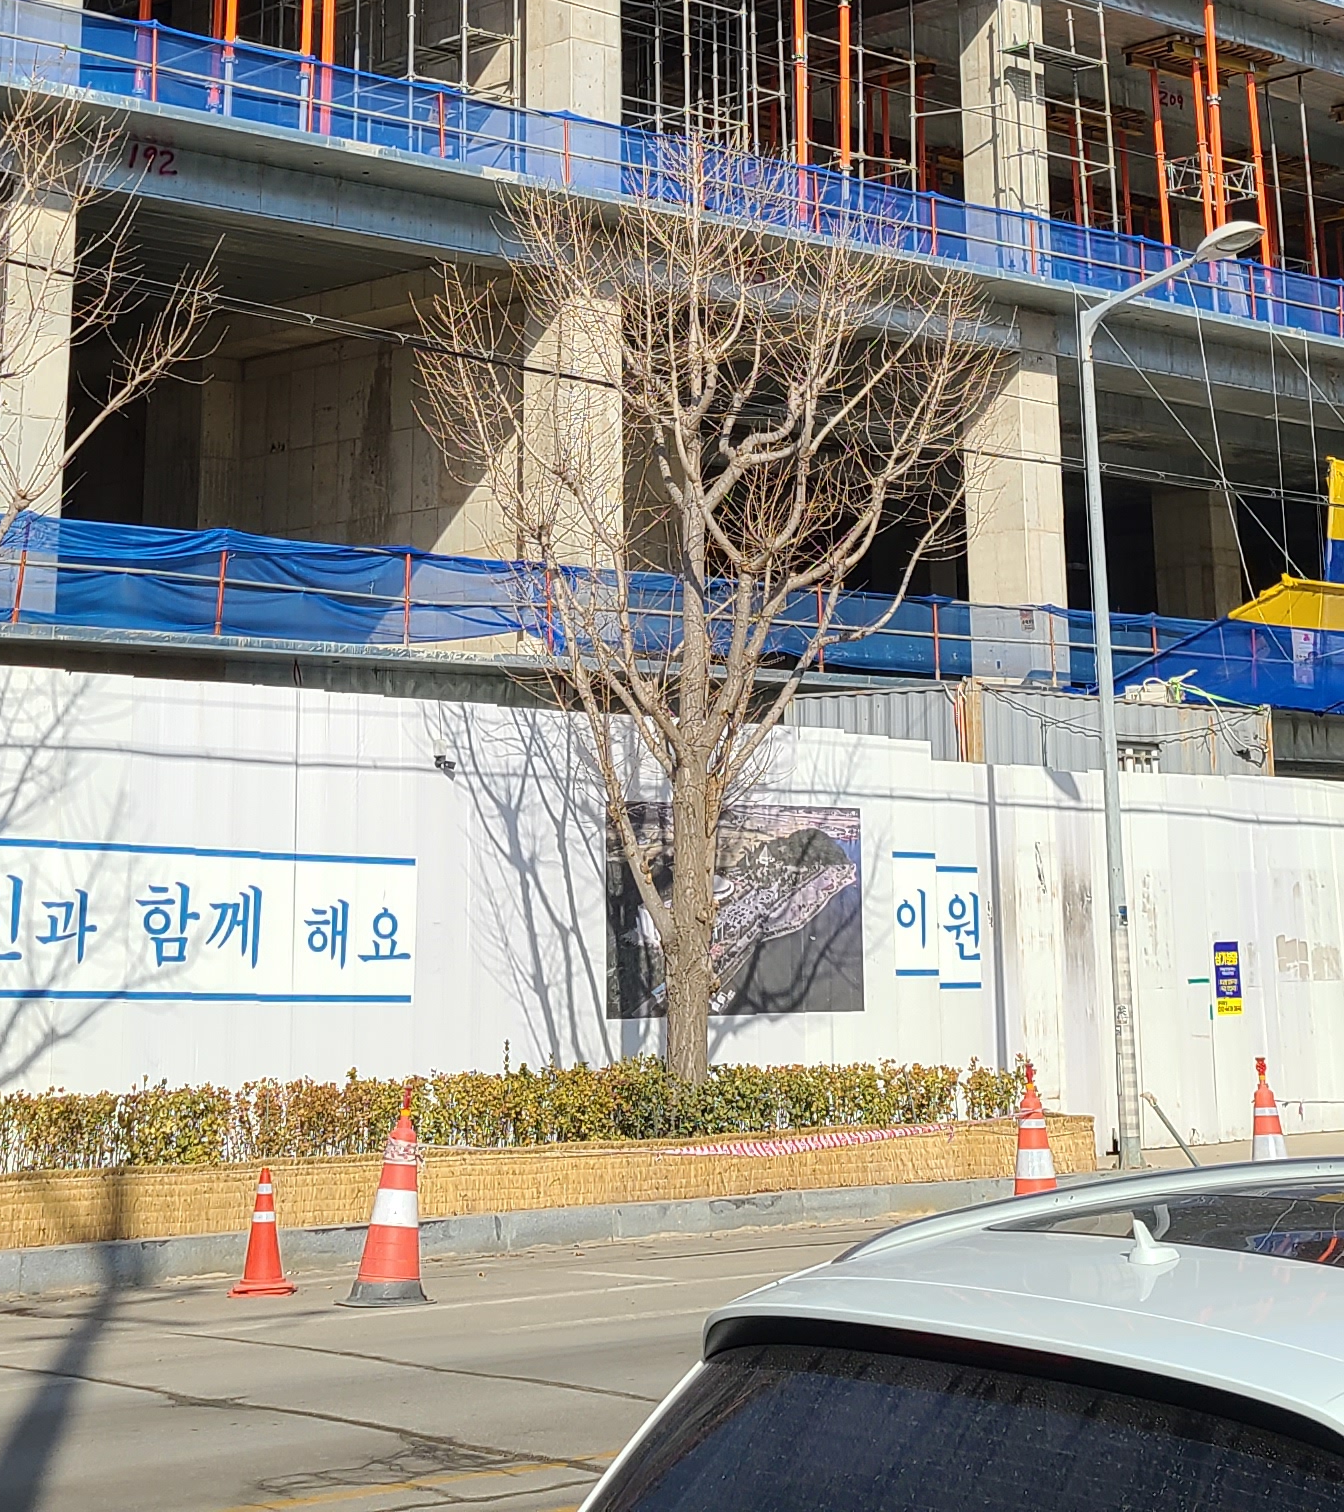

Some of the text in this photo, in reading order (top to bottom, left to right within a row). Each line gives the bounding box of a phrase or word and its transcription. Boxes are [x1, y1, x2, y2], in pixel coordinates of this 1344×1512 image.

[1158, 89, 1184, 110] 209
[128, 142, 178, 176] 192
[135, 880, 263, 970] 함께
[303, 898, 412, 970] 해요
[896, 888, 981, 961] 이원
